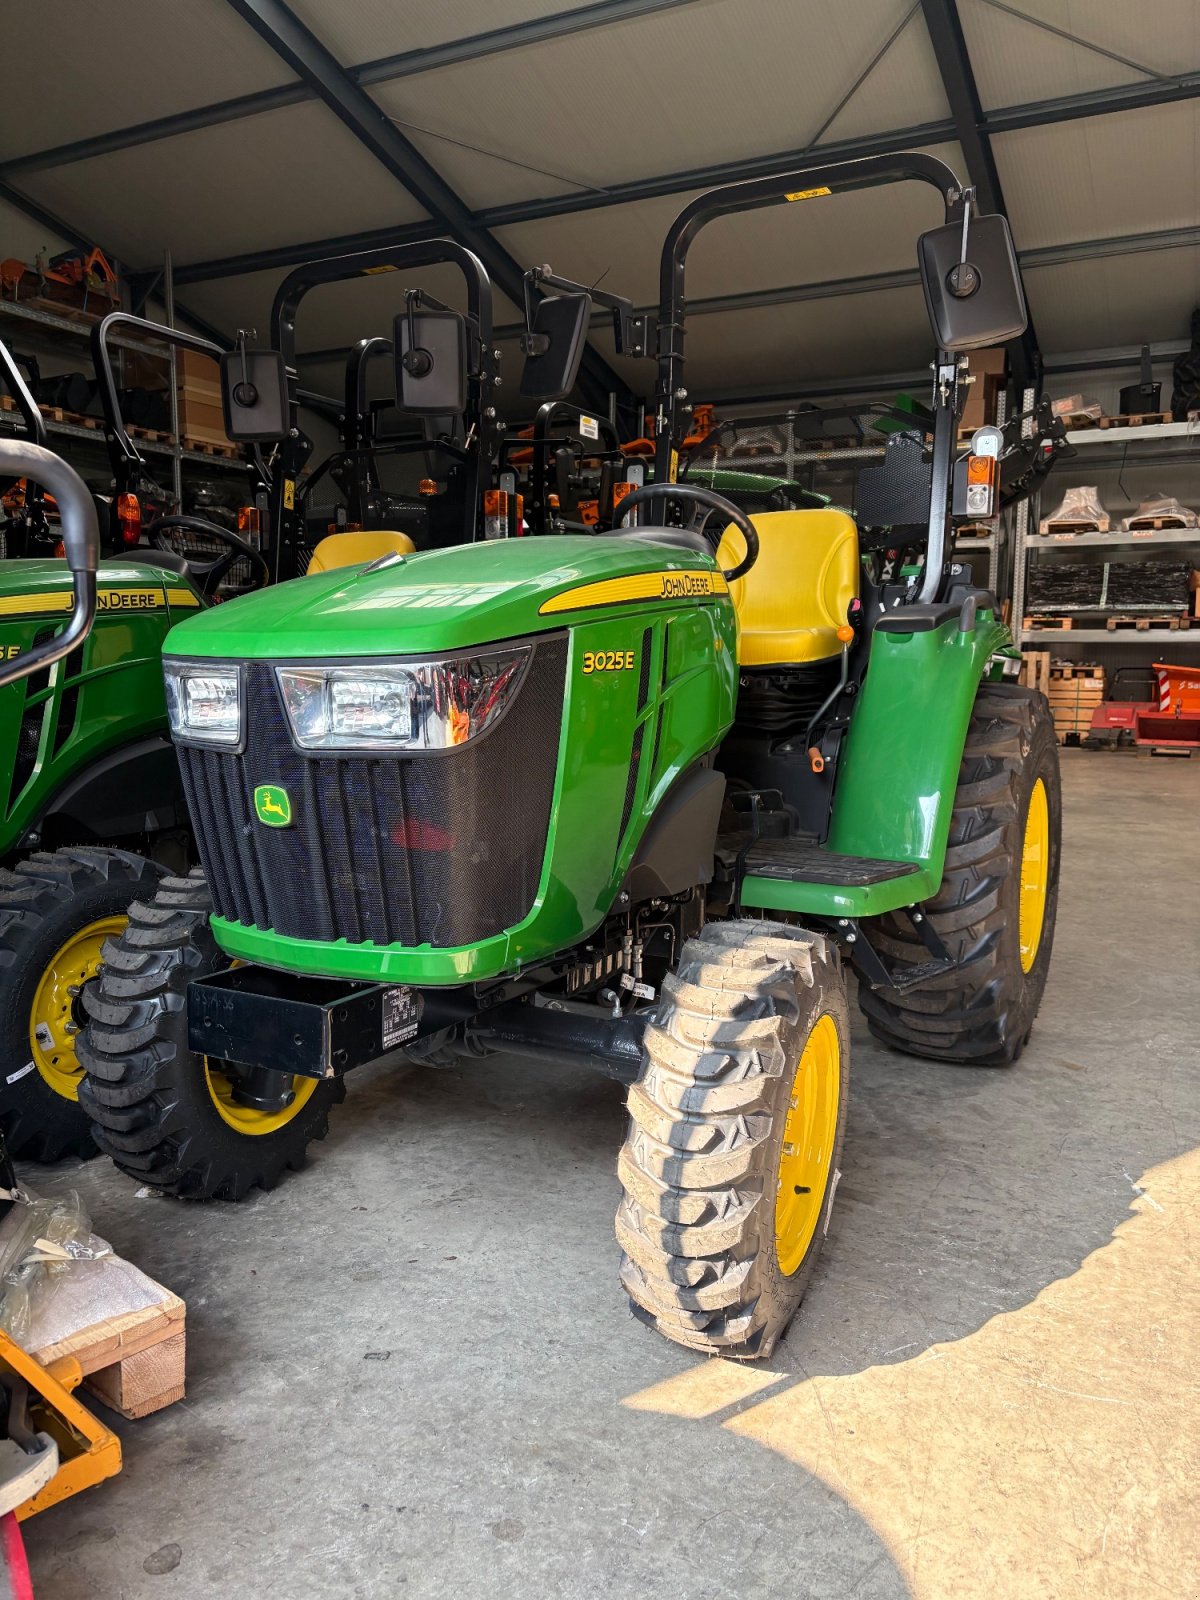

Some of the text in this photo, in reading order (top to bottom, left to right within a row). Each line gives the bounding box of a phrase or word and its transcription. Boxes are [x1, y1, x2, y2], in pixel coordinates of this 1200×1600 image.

[661, 574, 710, 596] JOHN DEERE
[65, 592, 156, 610] JN DEERE
[583, 650, 635, 675] 3025E
